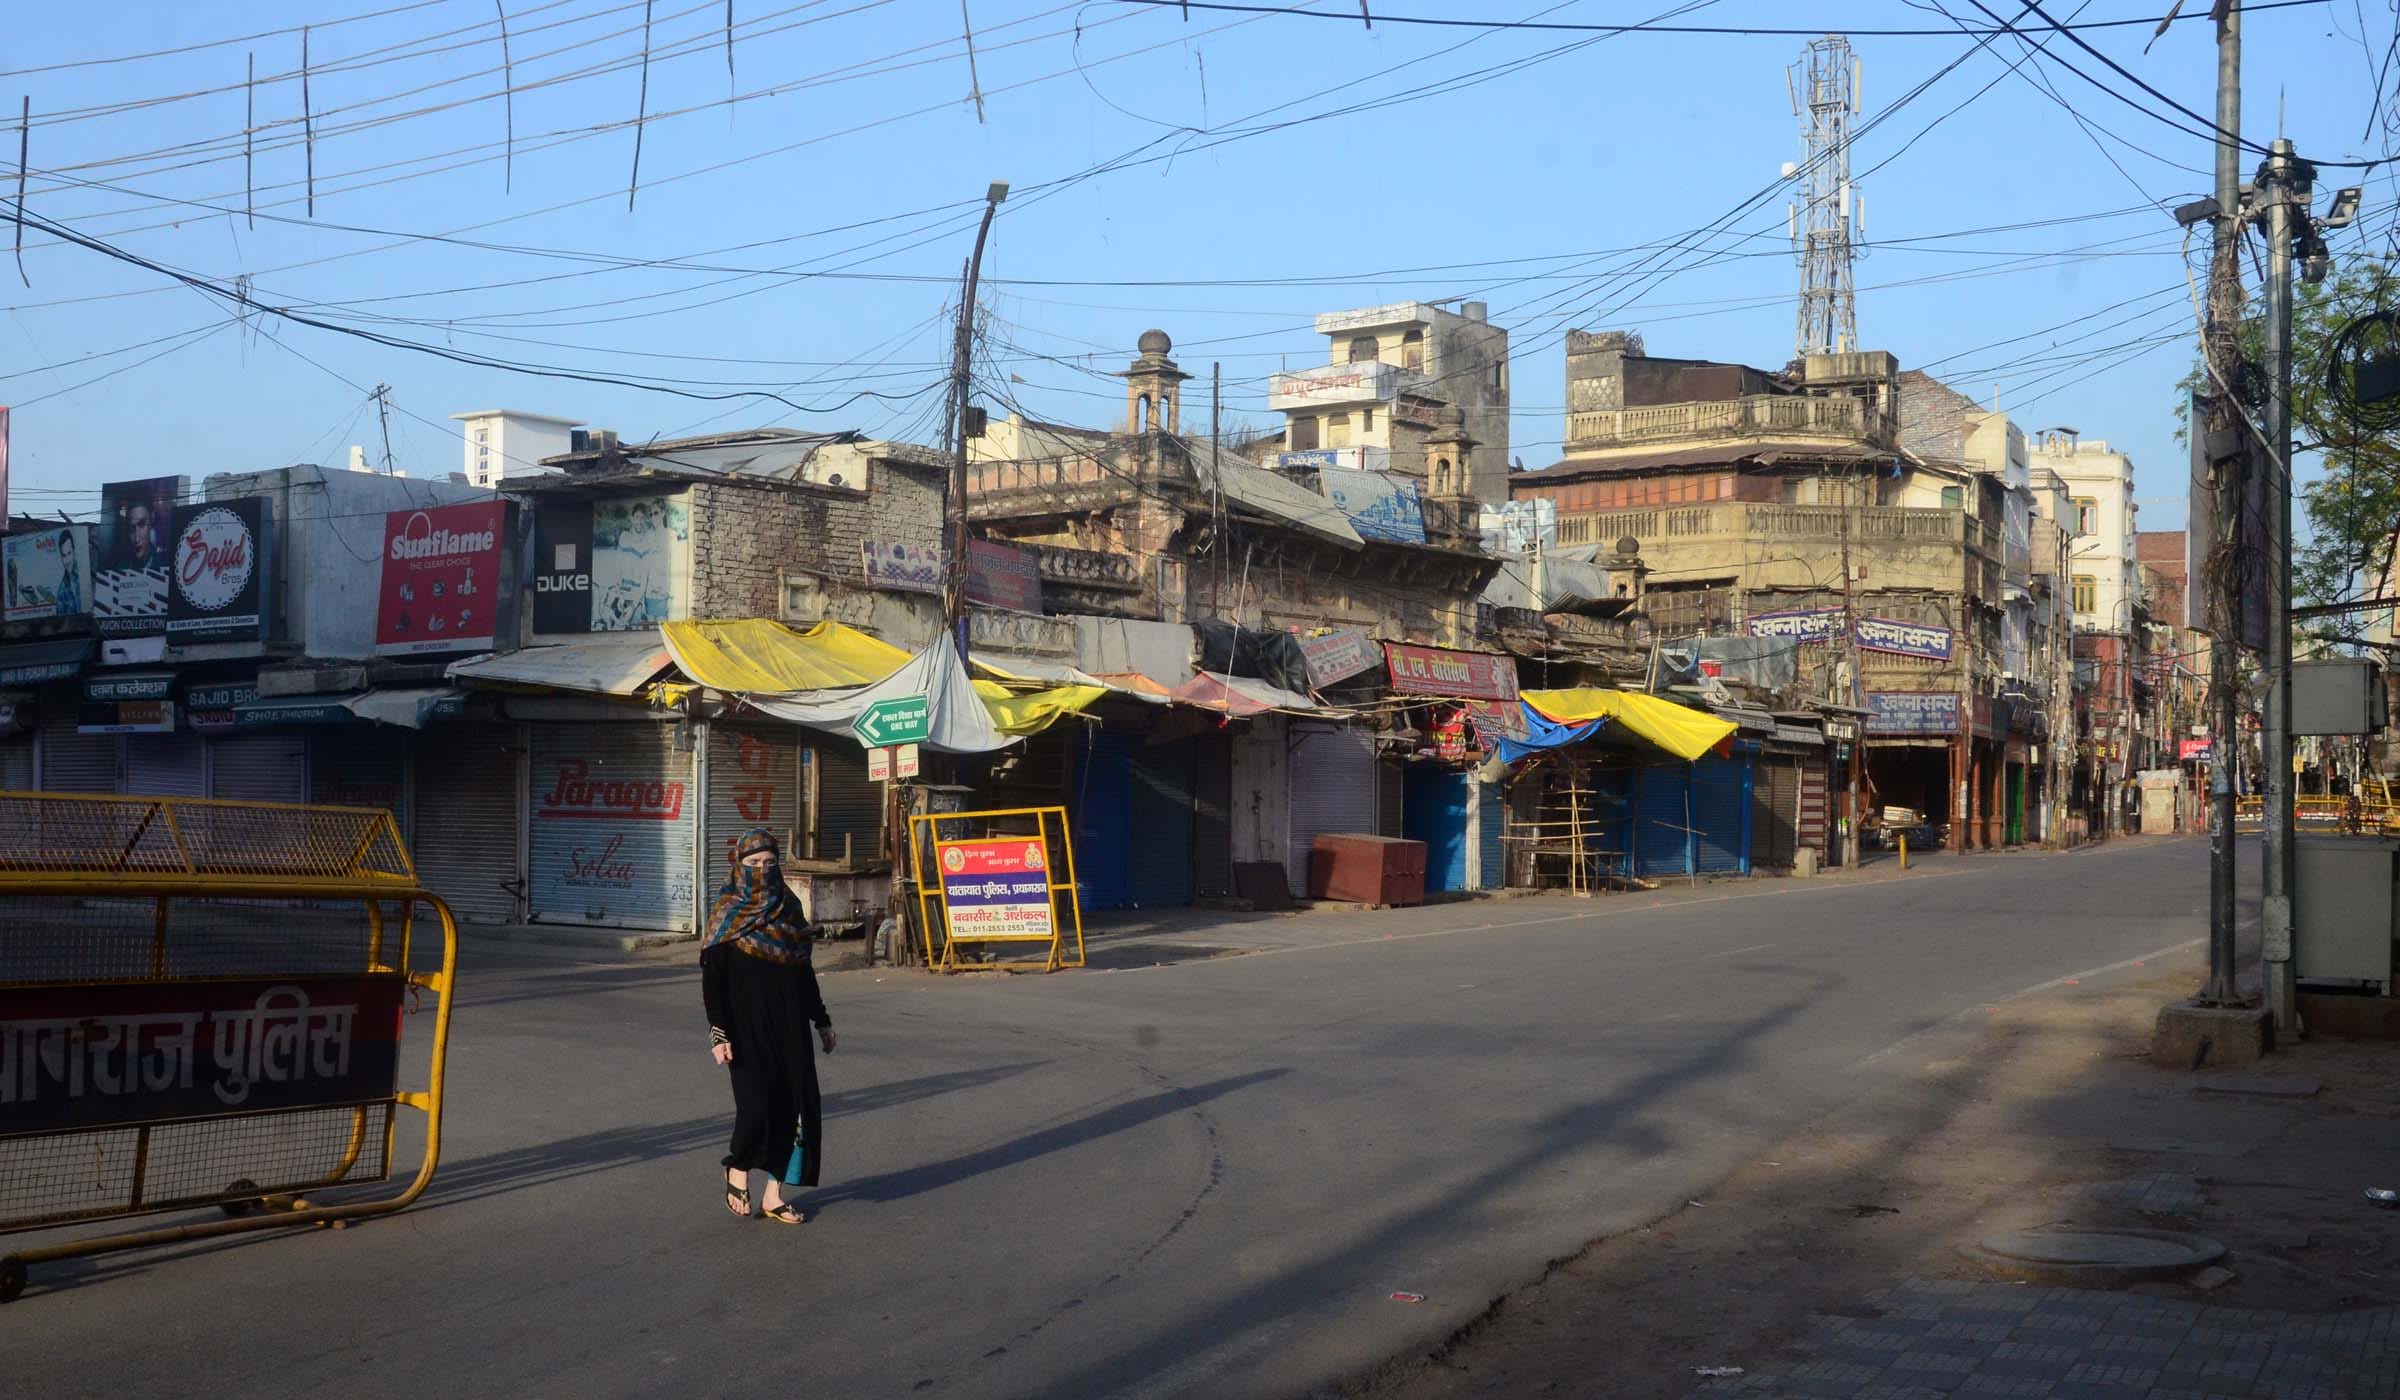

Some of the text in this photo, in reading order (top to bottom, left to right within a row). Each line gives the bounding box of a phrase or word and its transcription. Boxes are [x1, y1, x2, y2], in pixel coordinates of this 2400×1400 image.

[391, 519, 495, 559] Sunflame
[183, 530, 246, 585] Sajid
[409, 562, 422, 570] THE
[221, 573, 241, 585] Bros
[537, 575, 589, 592] DUKE
[190, 690, 229, 706] SAJID
[891, 720, 918, 731] ONE WAY
[543, 757, 684, 820] Paragon
[947, 881, 1047, 899] यातायात पुलिस, प्रयागराज
[952, 909, 992, 922] बवासीर
[1008, 924, 1024, 932] 2553
[211, 985, 360, 1105] पुलिस
